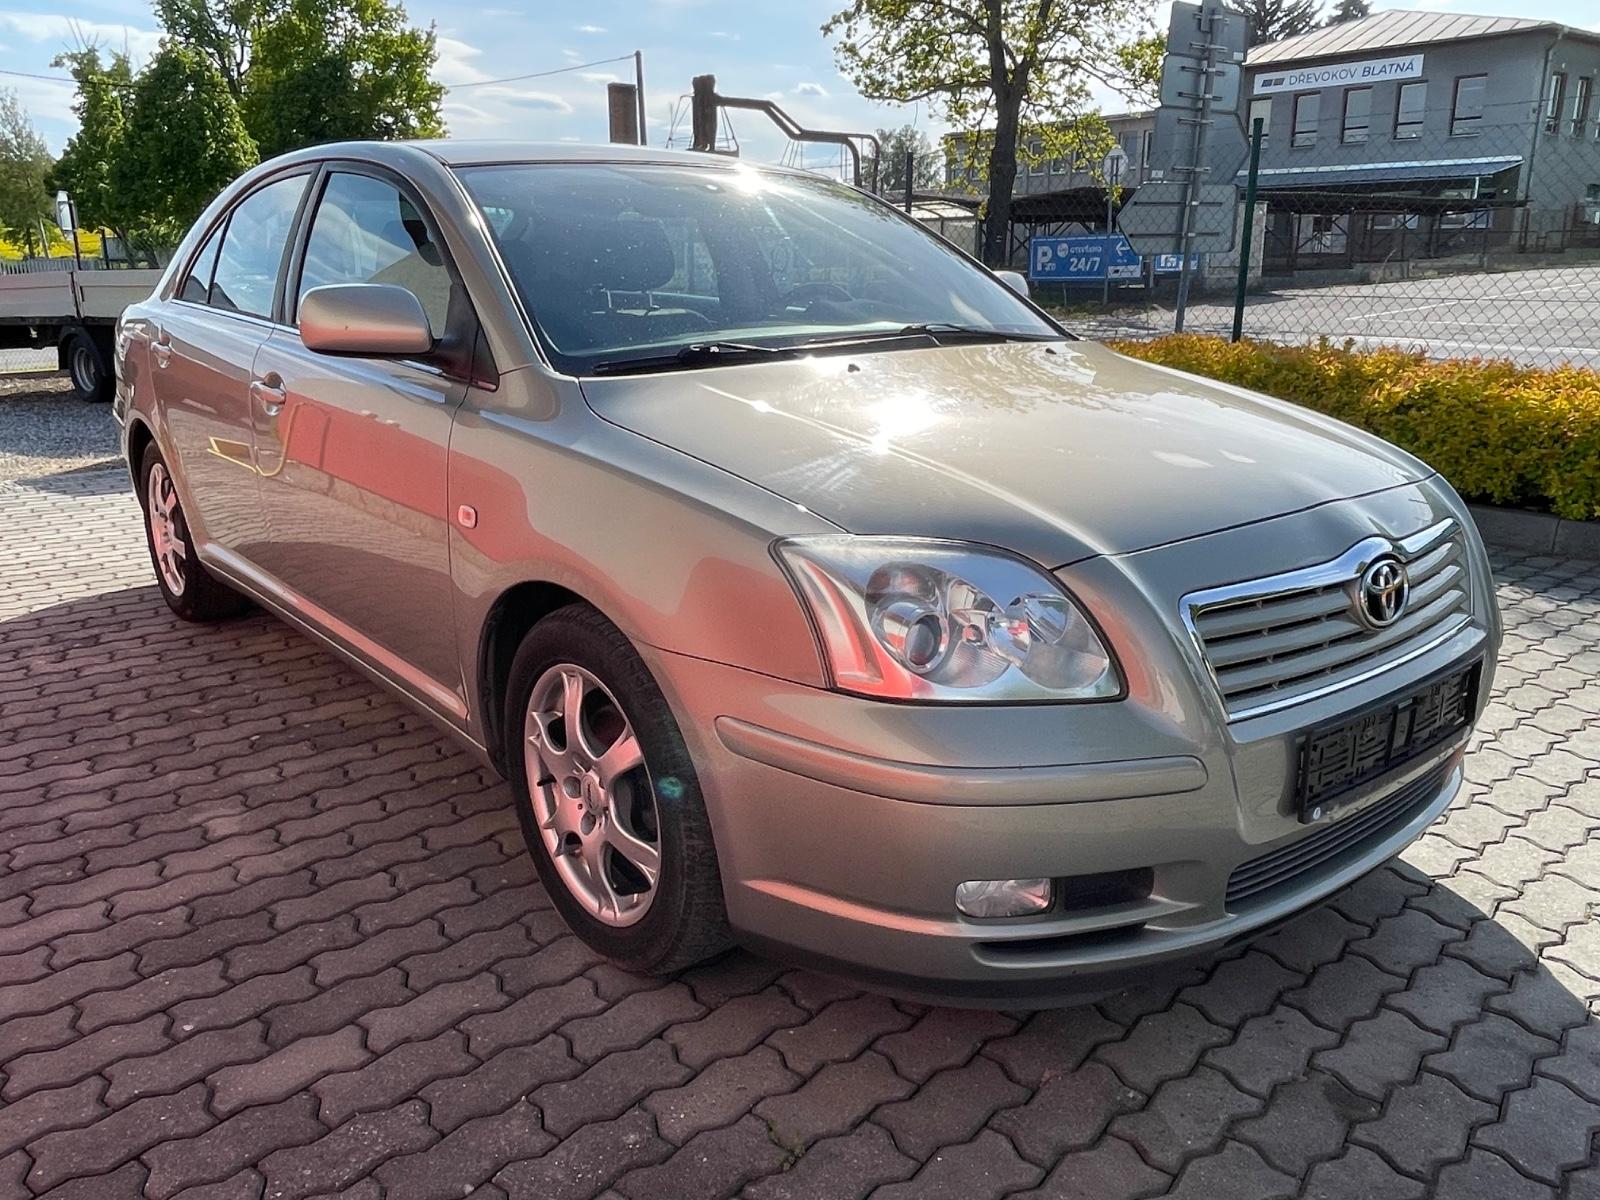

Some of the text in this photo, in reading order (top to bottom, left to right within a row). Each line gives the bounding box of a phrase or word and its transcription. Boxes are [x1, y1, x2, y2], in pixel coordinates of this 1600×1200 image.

[1289, 59, 1415, 86] DŘEVOKOV BLATNÁ
[1069, 257, 1101, 272] 24/7
